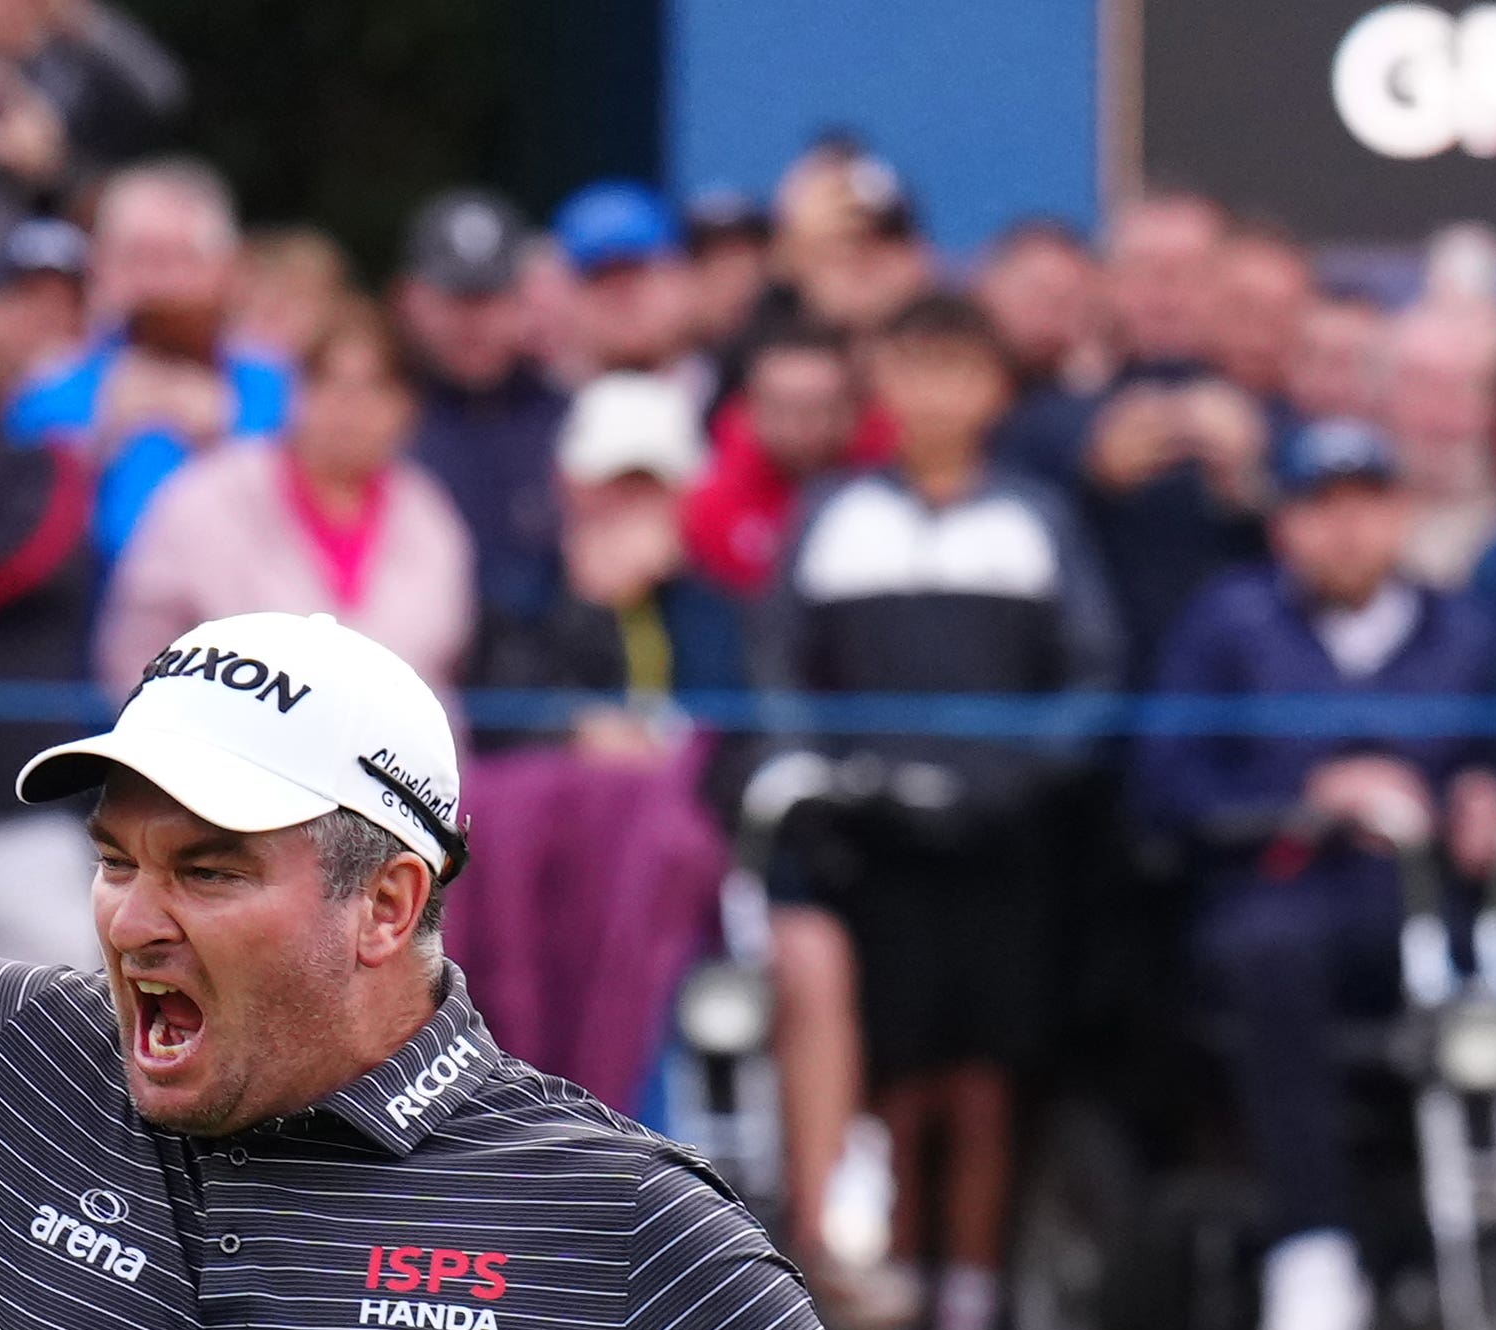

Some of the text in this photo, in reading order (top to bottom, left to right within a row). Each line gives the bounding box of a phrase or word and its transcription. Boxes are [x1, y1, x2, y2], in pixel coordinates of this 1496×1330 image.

[142, 646, 312, 714] RIXON
[385, 1035, 481, 1130] RICOH
[30, 1204, 147, 1283] arena
[365, 1246, 510, 1301] ISPS
